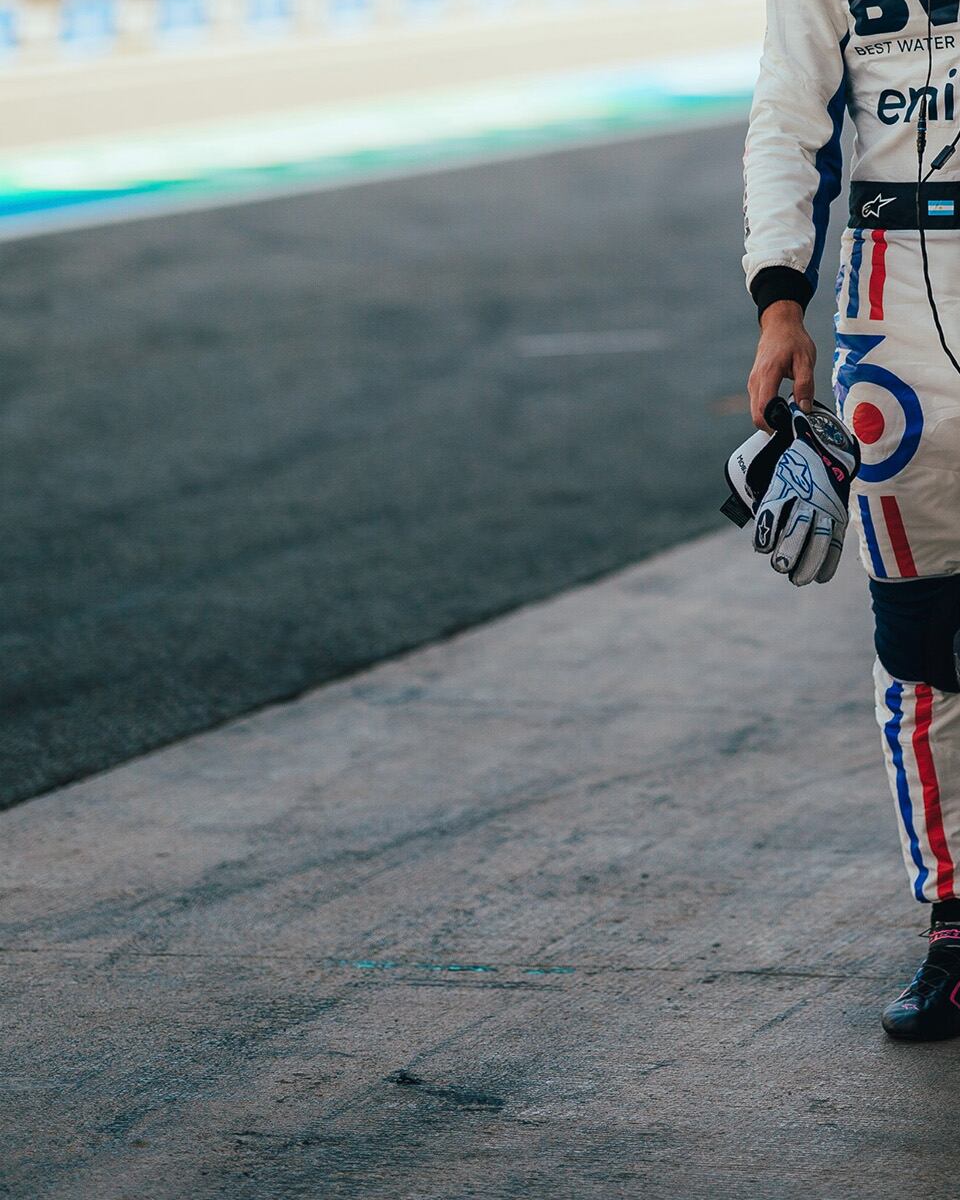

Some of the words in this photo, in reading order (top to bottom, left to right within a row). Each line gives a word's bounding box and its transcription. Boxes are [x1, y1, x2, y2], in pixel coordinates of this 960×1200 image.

[854, 41, 892, 56] BEST
[897, 35, 955, 52] WATER
[877, 68, 957, 125] eni
